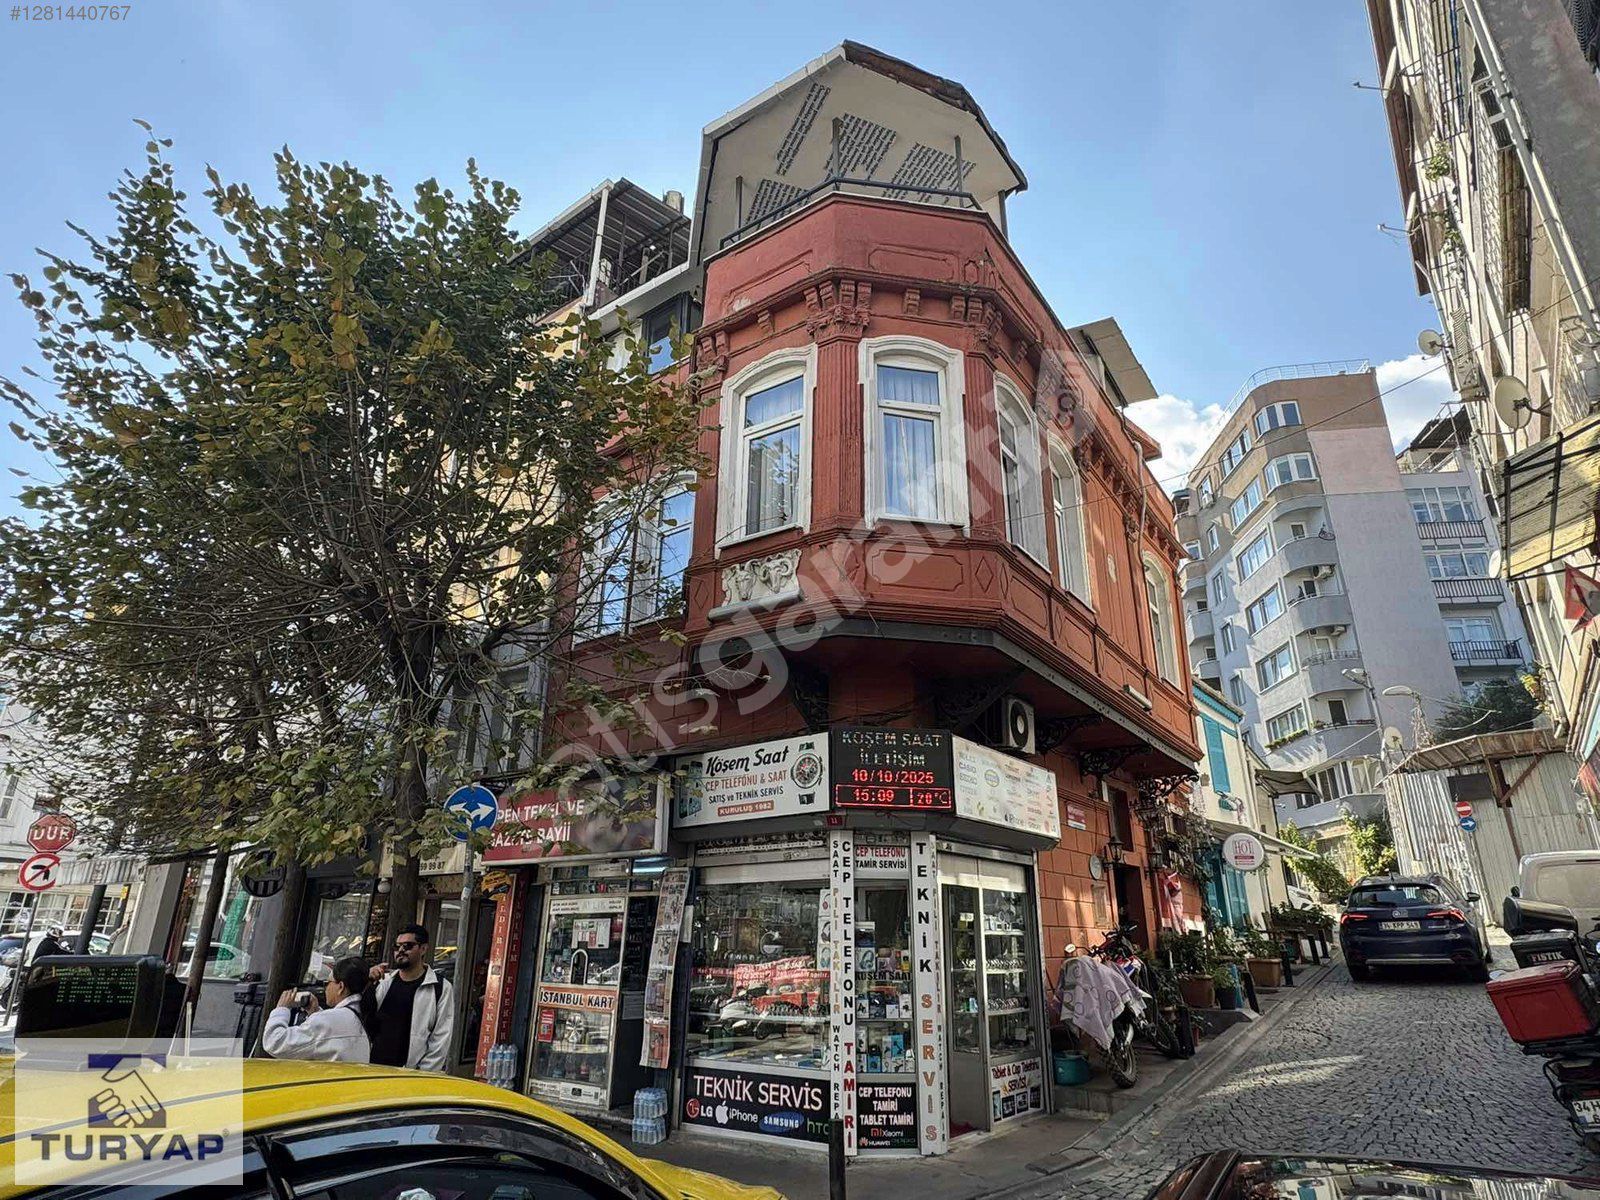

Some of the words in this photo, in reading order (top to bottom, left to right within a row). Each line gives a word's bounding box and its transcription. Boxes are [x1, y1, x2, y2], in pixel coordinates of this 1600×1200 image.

[902, 733, 942, 746] SAAT
[706, 755, 750, 776] Köşem
[753, 745, 789, 766] Saat
[705, 780, 720, 792] CEP
[721, 775, 758, 789] TELEFONU
[760, 773, 765, 784] &
[768, 769, 787, 782] SAAT
[852, 768, 934, 784] 10/10/2025
[708, 794, 726, 804] SATIŞ
[736, 787, 759, 800] TEKNİK
[760, 785, 784, 796] SERVİS
[853, 788, 895, 802] 15:09
[719, 804, 753, 815] KURULUŞ
[33, 825, 71, 840] DUR
[855, 846, 868, 857] CEP
[870, 847, 906, 857] TELEFONU
[842, 841, 851, 883] CEP
[855, 858, 877, 868] TAMİR
[916, 842, 933, 973] TEKNİK
[843, 897, 853, 1026] TELEFONU
[588, 995, 614, 1008] KART
[832, 1025, 841, 1071] WATCH
[693, 1074, 753, 1103] TEKNİK
[758, 1081, 823, 1111] SERVİS
[858, 1087, 873, 1098] CEP
[874, 1087, 912, 1098] TELEFONU
[873, 1099, 898, 1112] TAMİRİ
[1574, 1100, 1590, 1112] 34
[701, 1104, 713, 1118] LG
[729, 1106, 758, 1123] iPhone
[764, 1115, 799, 1128] SAMSUNG
[860, 1115, 888, 1126] TABLET
[889, 1113, 914, 1126] TAMİRİ
